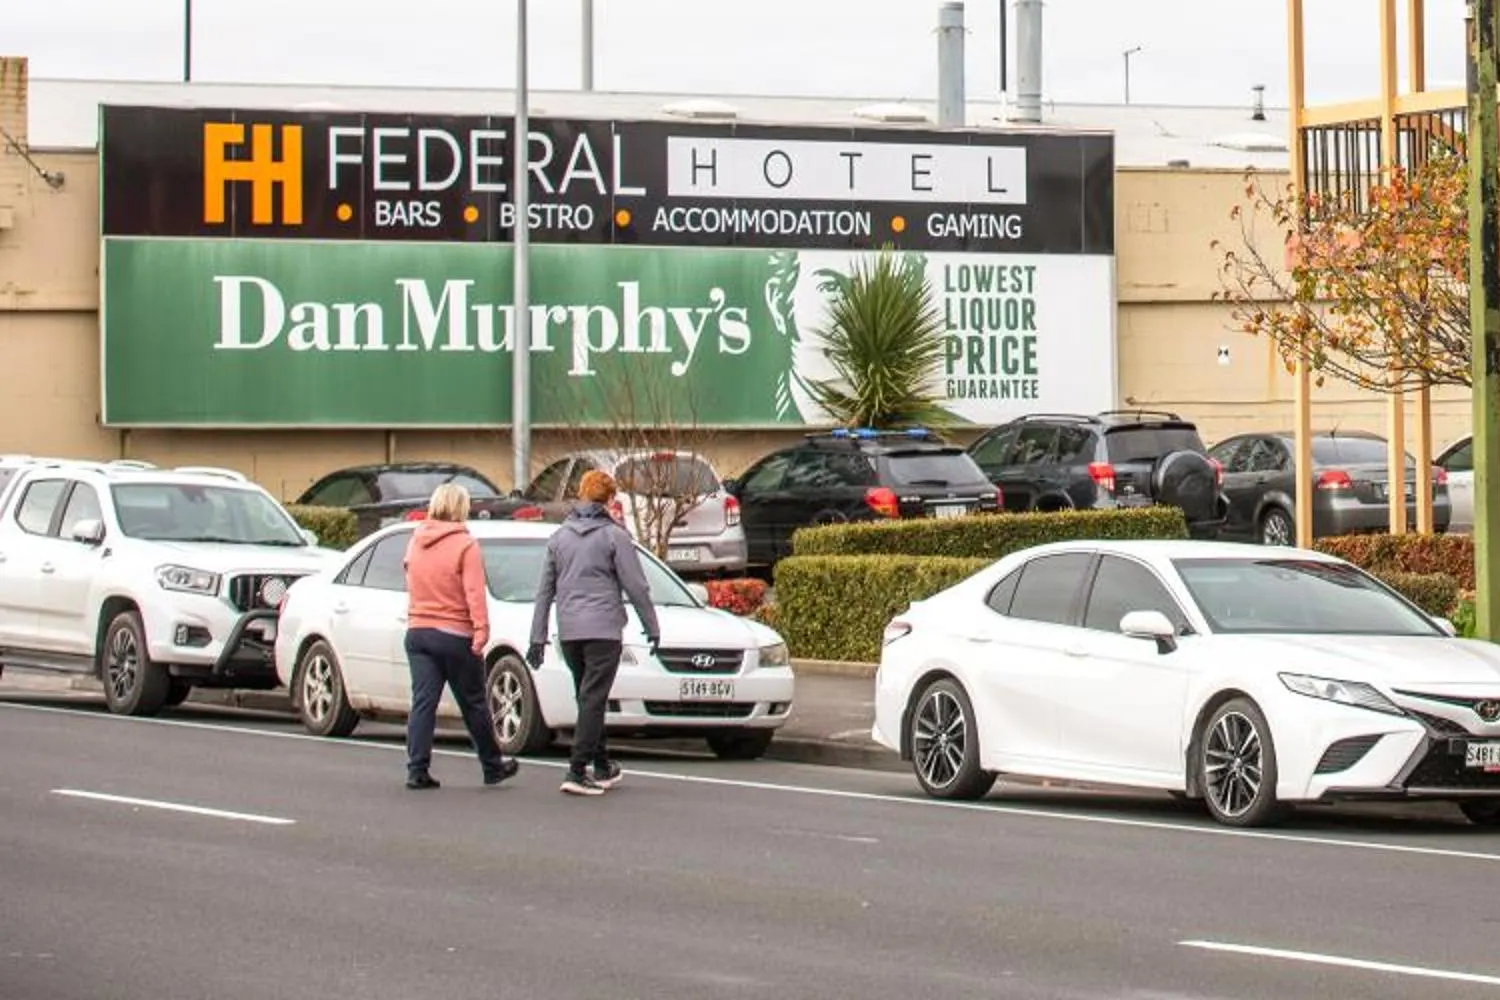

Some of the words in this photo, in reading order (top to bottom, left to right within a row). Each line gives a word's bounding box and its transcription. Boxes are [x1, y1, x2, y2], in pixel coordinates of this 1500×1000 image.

[204, 122, 303, 225] FH
[328, 126, 646, 197] FEDERAL
[690, 147, 1008, 194] HOTEL
[375, 201, 441, 228] BARS
[500, 202, 594, 230] BSTRO
[652, 207, 871, 236] ACCOMMODATION
[927, 213, 1022, 239] GAMING
[944, 263, 1037, 294] LOWEST
[213, 275, 389, 350] Dan
[395, 278, 752, 377] Murphy's
[944, 297, 1037, 334] LIQUOR
[944, 335, 1039, 375] PRICE
[946, 379, 1040, 399] GUARANTEE
